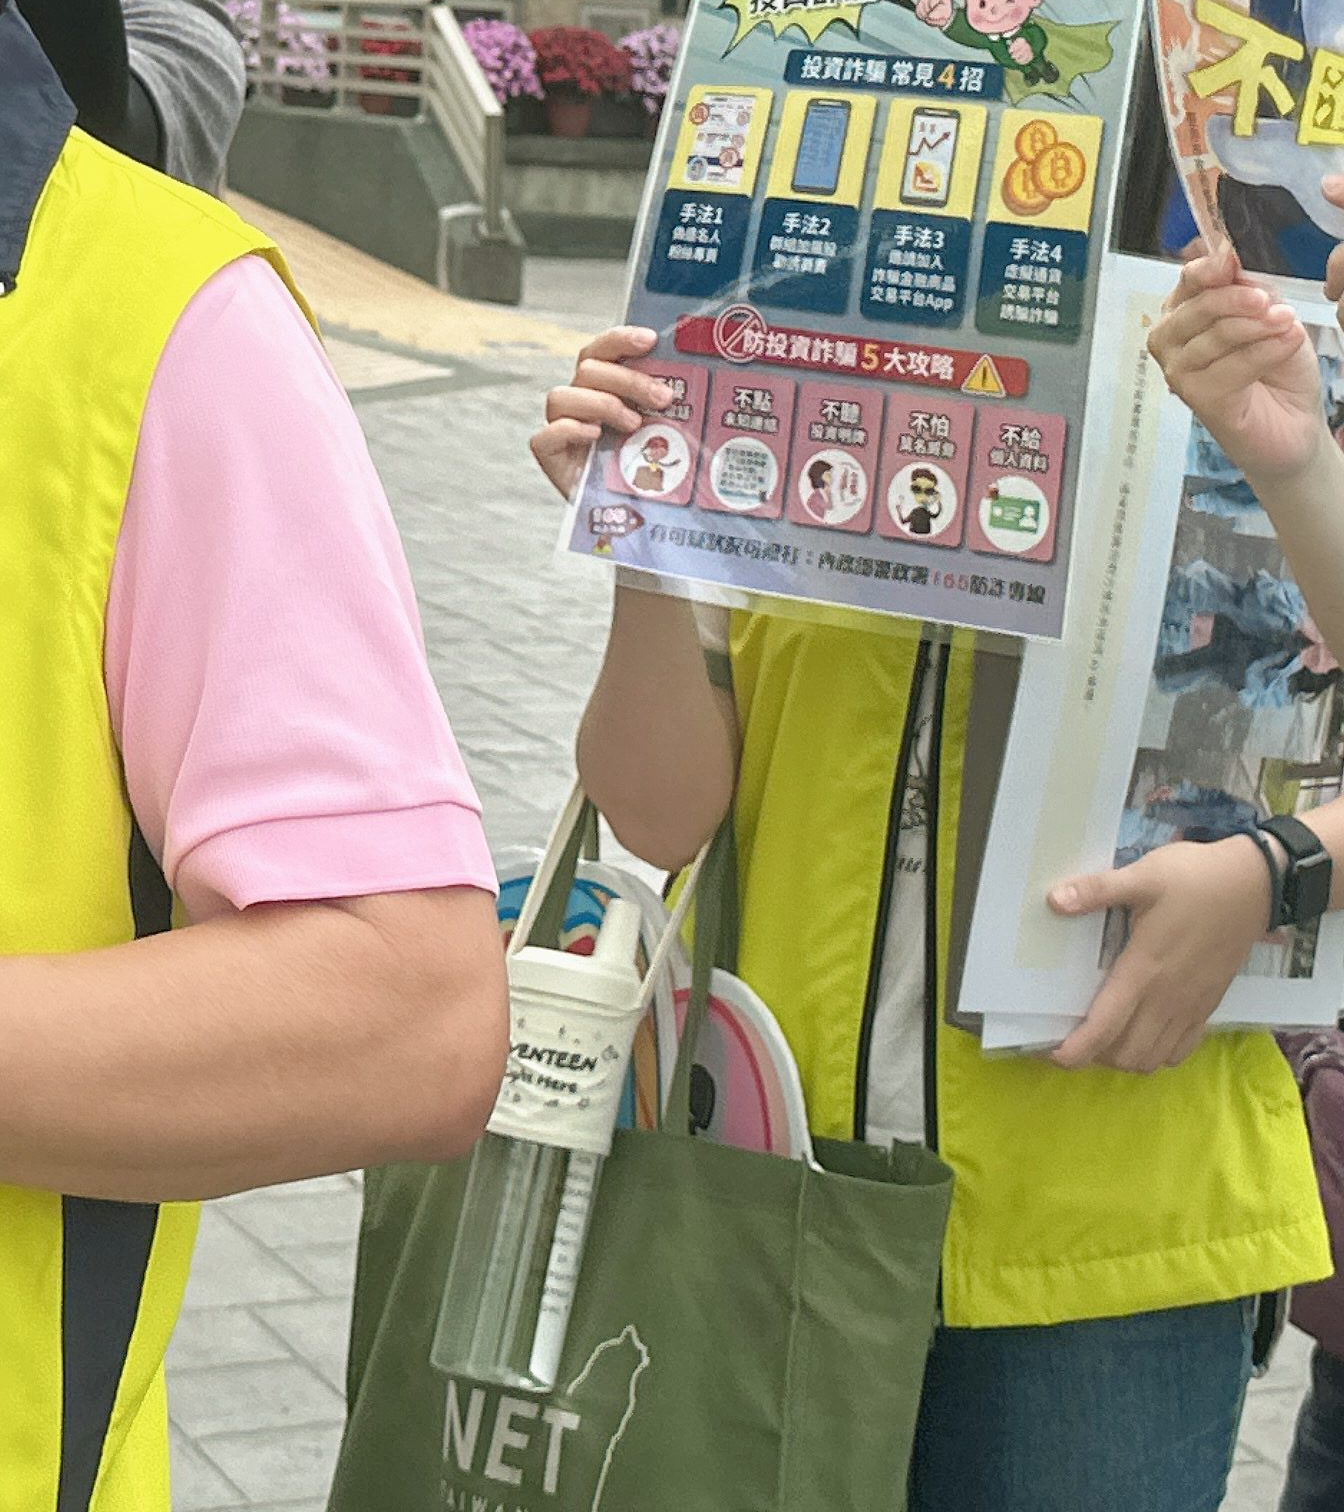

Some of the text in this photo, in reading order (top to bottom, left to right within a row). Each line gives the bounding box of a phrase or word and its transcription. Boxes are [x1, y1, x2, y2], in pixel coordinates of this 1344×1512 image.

[678, 202, 724, 225] 手法1
[781, 211, 833, 236] 手法2
[894, 224, 946, 249] 手法3
[1009, 237, 1063, 263] 手法4
[734, 387, 773, 413] 不點
[909, 411, 952, 438] 不怕
[1000, 424, 1043, 451] 不給
